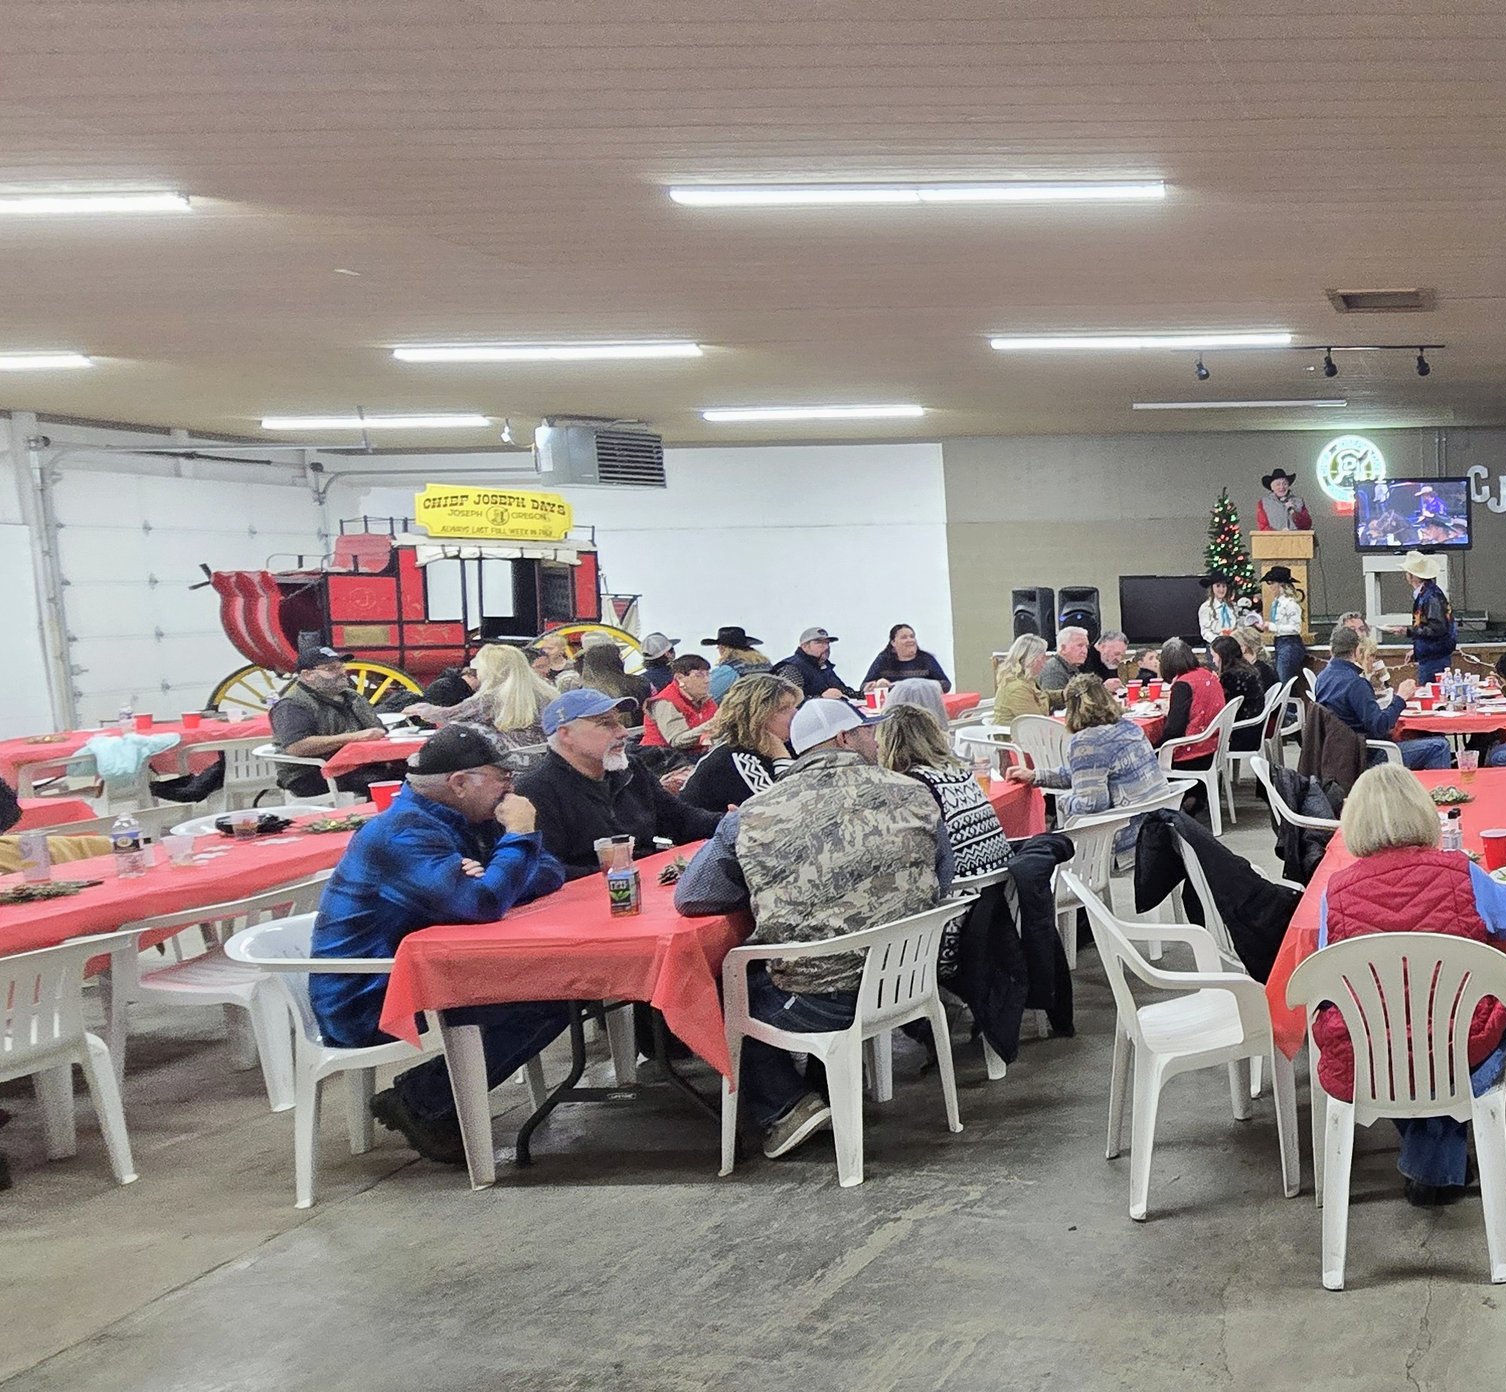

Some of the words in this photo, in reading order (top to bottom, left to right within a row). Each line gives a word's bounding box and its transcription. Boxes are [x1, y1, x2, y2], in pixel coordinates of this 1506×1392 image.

[423, 494, 469, 509] CHIEF
[473, 494, 526, 508] JOSEPH
[530, 499, 566, 516] DAYS
[448, 509, 483, 518] JOSEPH
[511, 511, 547, 521] OREGON
[471, 526, 489, 535] LAST
[510, 527, 529, 536] WEEK
